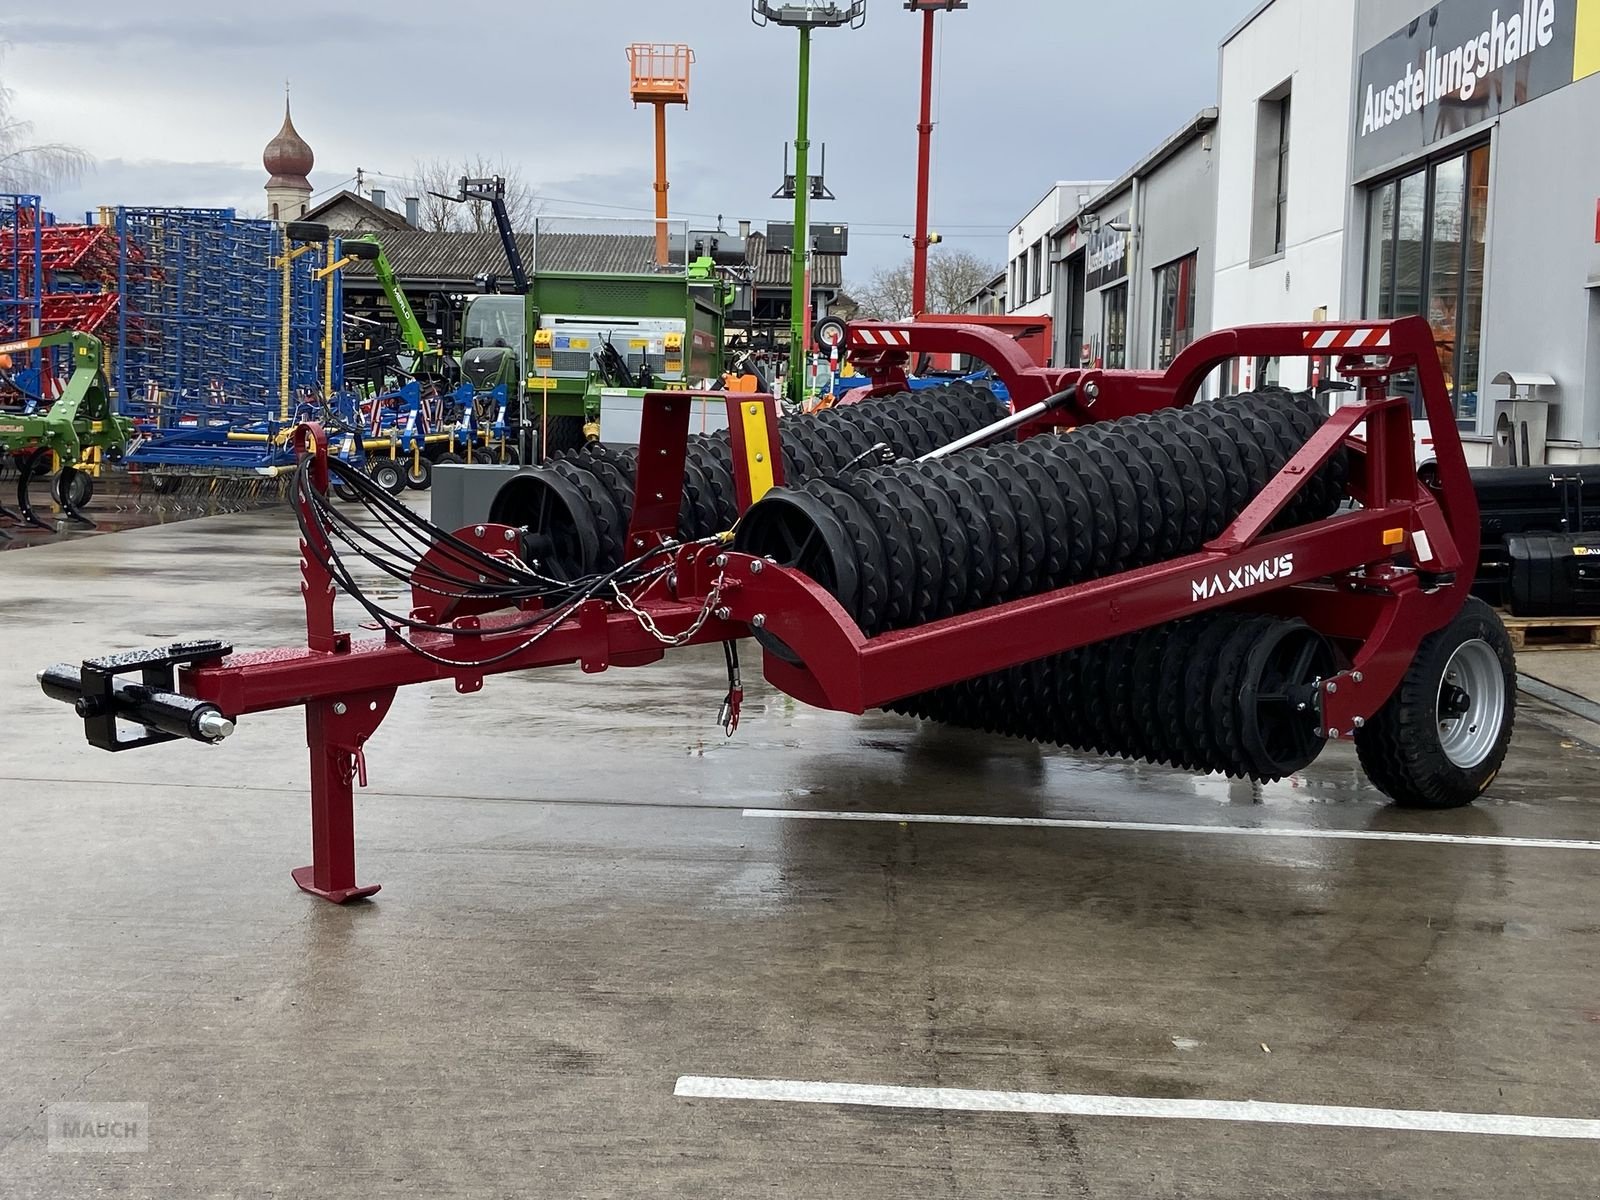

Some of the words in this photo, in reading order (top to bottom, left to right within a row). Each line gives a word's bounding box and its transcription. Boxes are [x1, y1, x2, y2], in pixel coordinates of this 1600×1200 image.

[1361, 0, 1555, 137] Ausstellungshalle
[393, 287, 410, 320] MERLO
[1192, 553, 1294, 602] MAXIMUS
